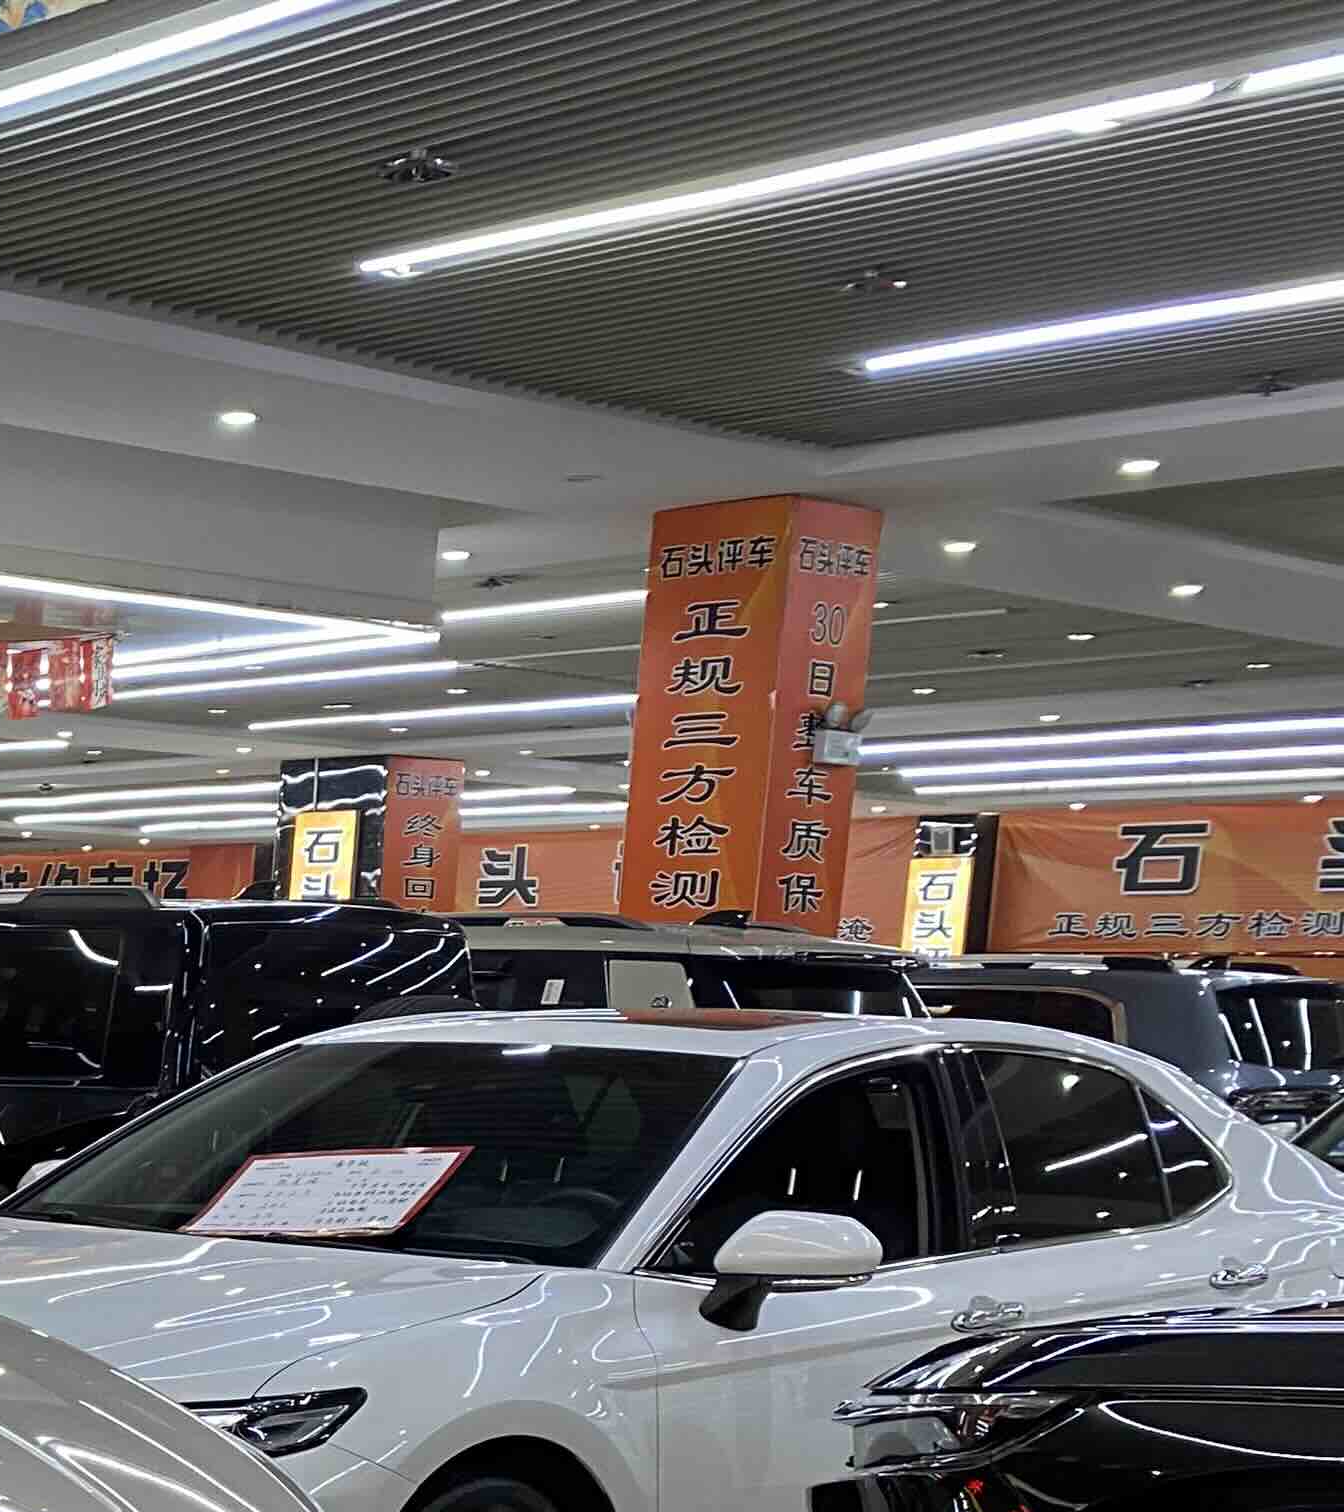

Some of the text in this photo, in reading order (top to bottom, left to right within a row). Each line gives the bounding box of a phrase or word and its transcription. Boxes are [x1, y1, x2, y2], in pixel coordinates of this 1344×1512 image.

[661, 535, 777, 580] 石头评车
[798, 537, 871, 577] 石头评车
[649, 600, 750, 911] 正规三方检测
[402, 813, 444, 912] 终身回
[1048, 910, 1344, 942] 正规三方检测
